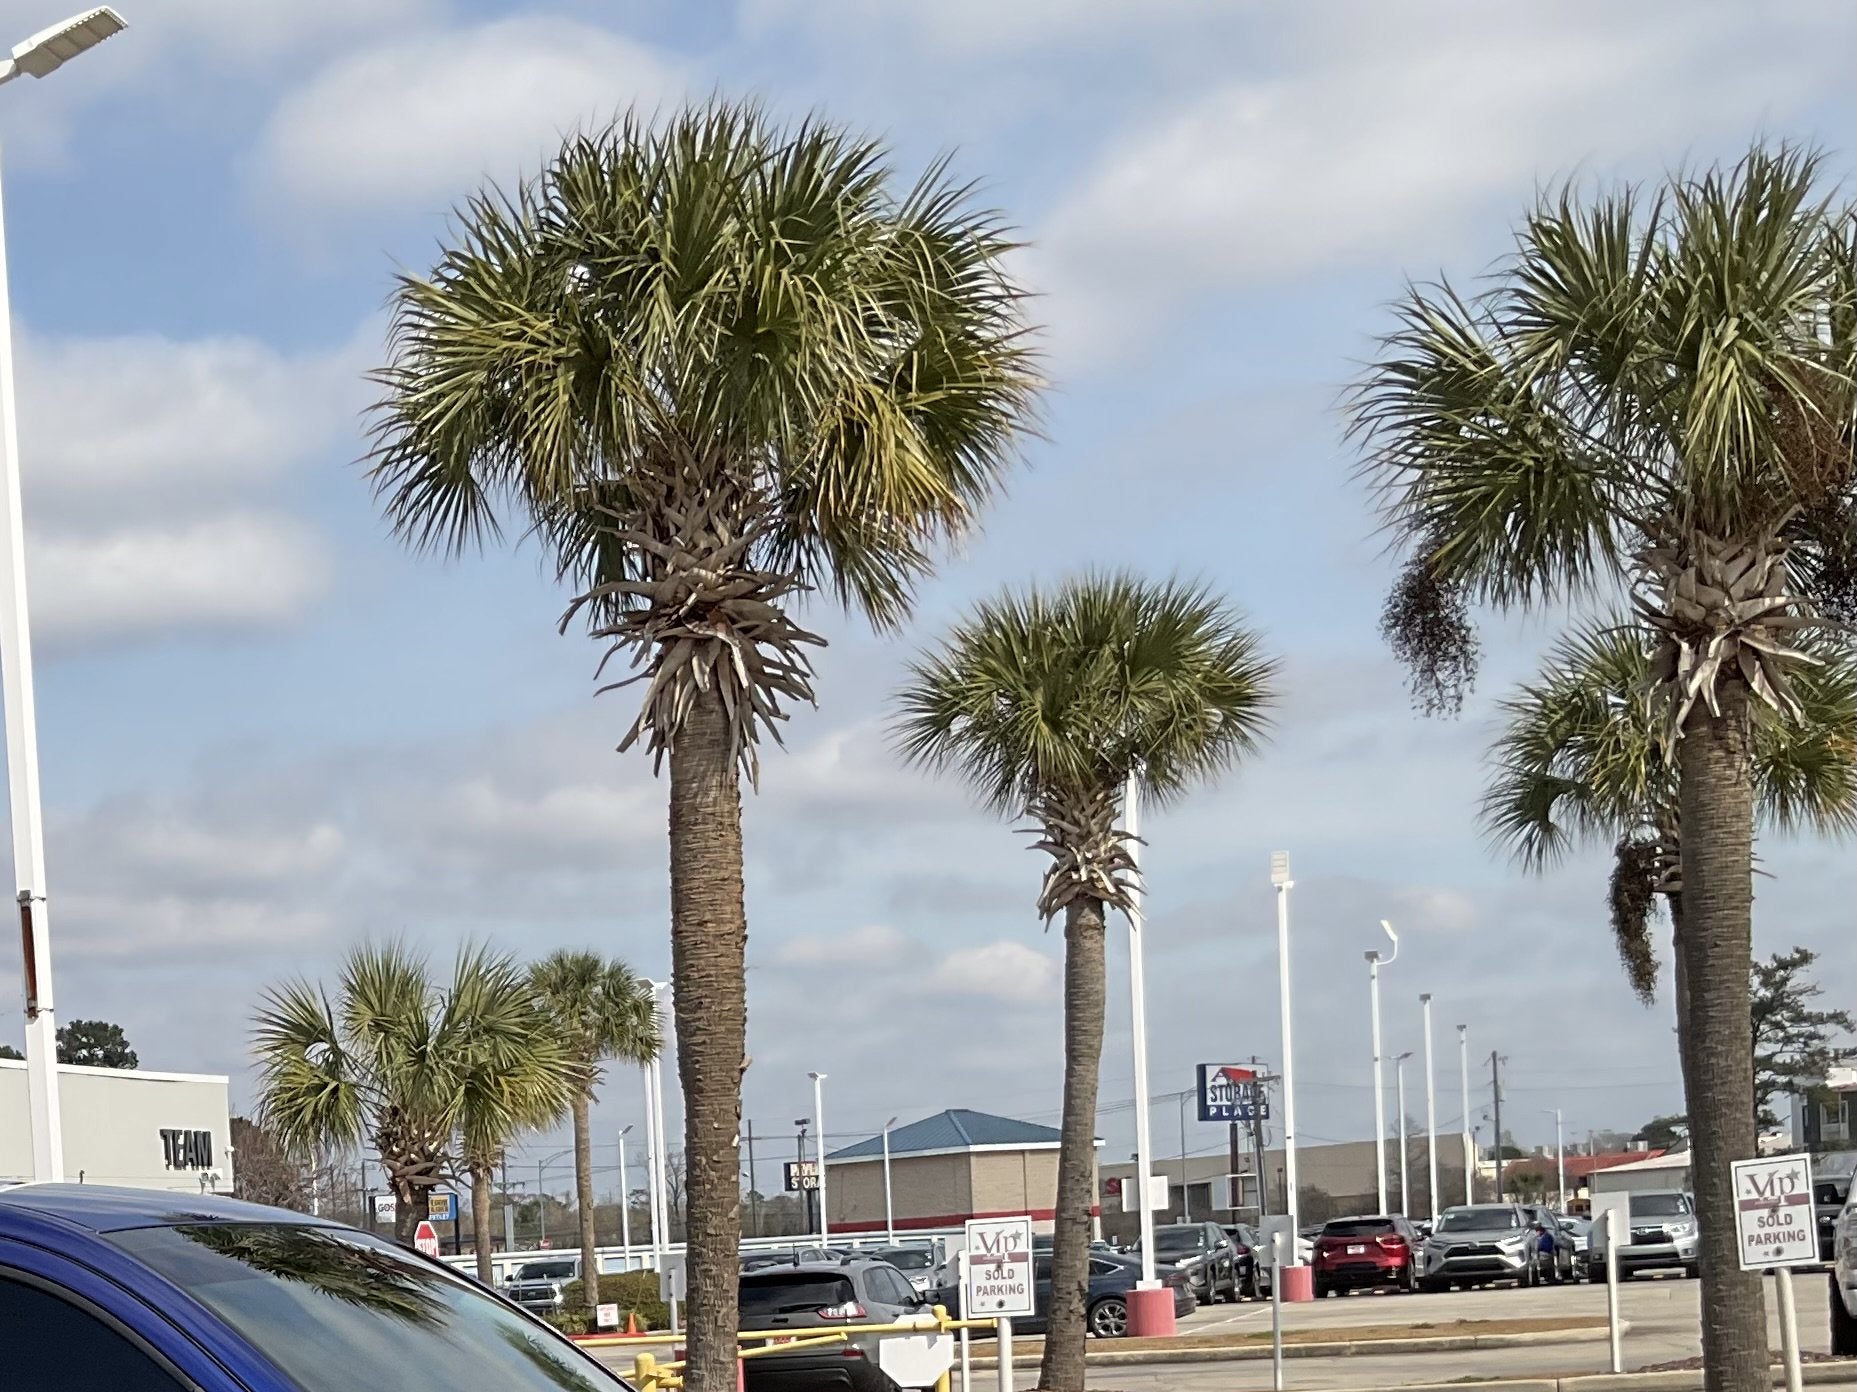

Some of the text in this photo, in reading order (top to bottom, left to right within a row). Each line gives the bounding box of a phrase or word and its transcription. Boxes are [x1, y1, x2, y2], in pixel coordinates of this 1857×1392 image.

[159, 1129, 212, 1168] TEAM
[1757, 1213, 1792, 1228] SOLD
[1748, 1229, 1806, 1246] PARKING
[985, 1268, 1015, 1280] SOLD
[976, 1284, 1024, 1296] PARKING
